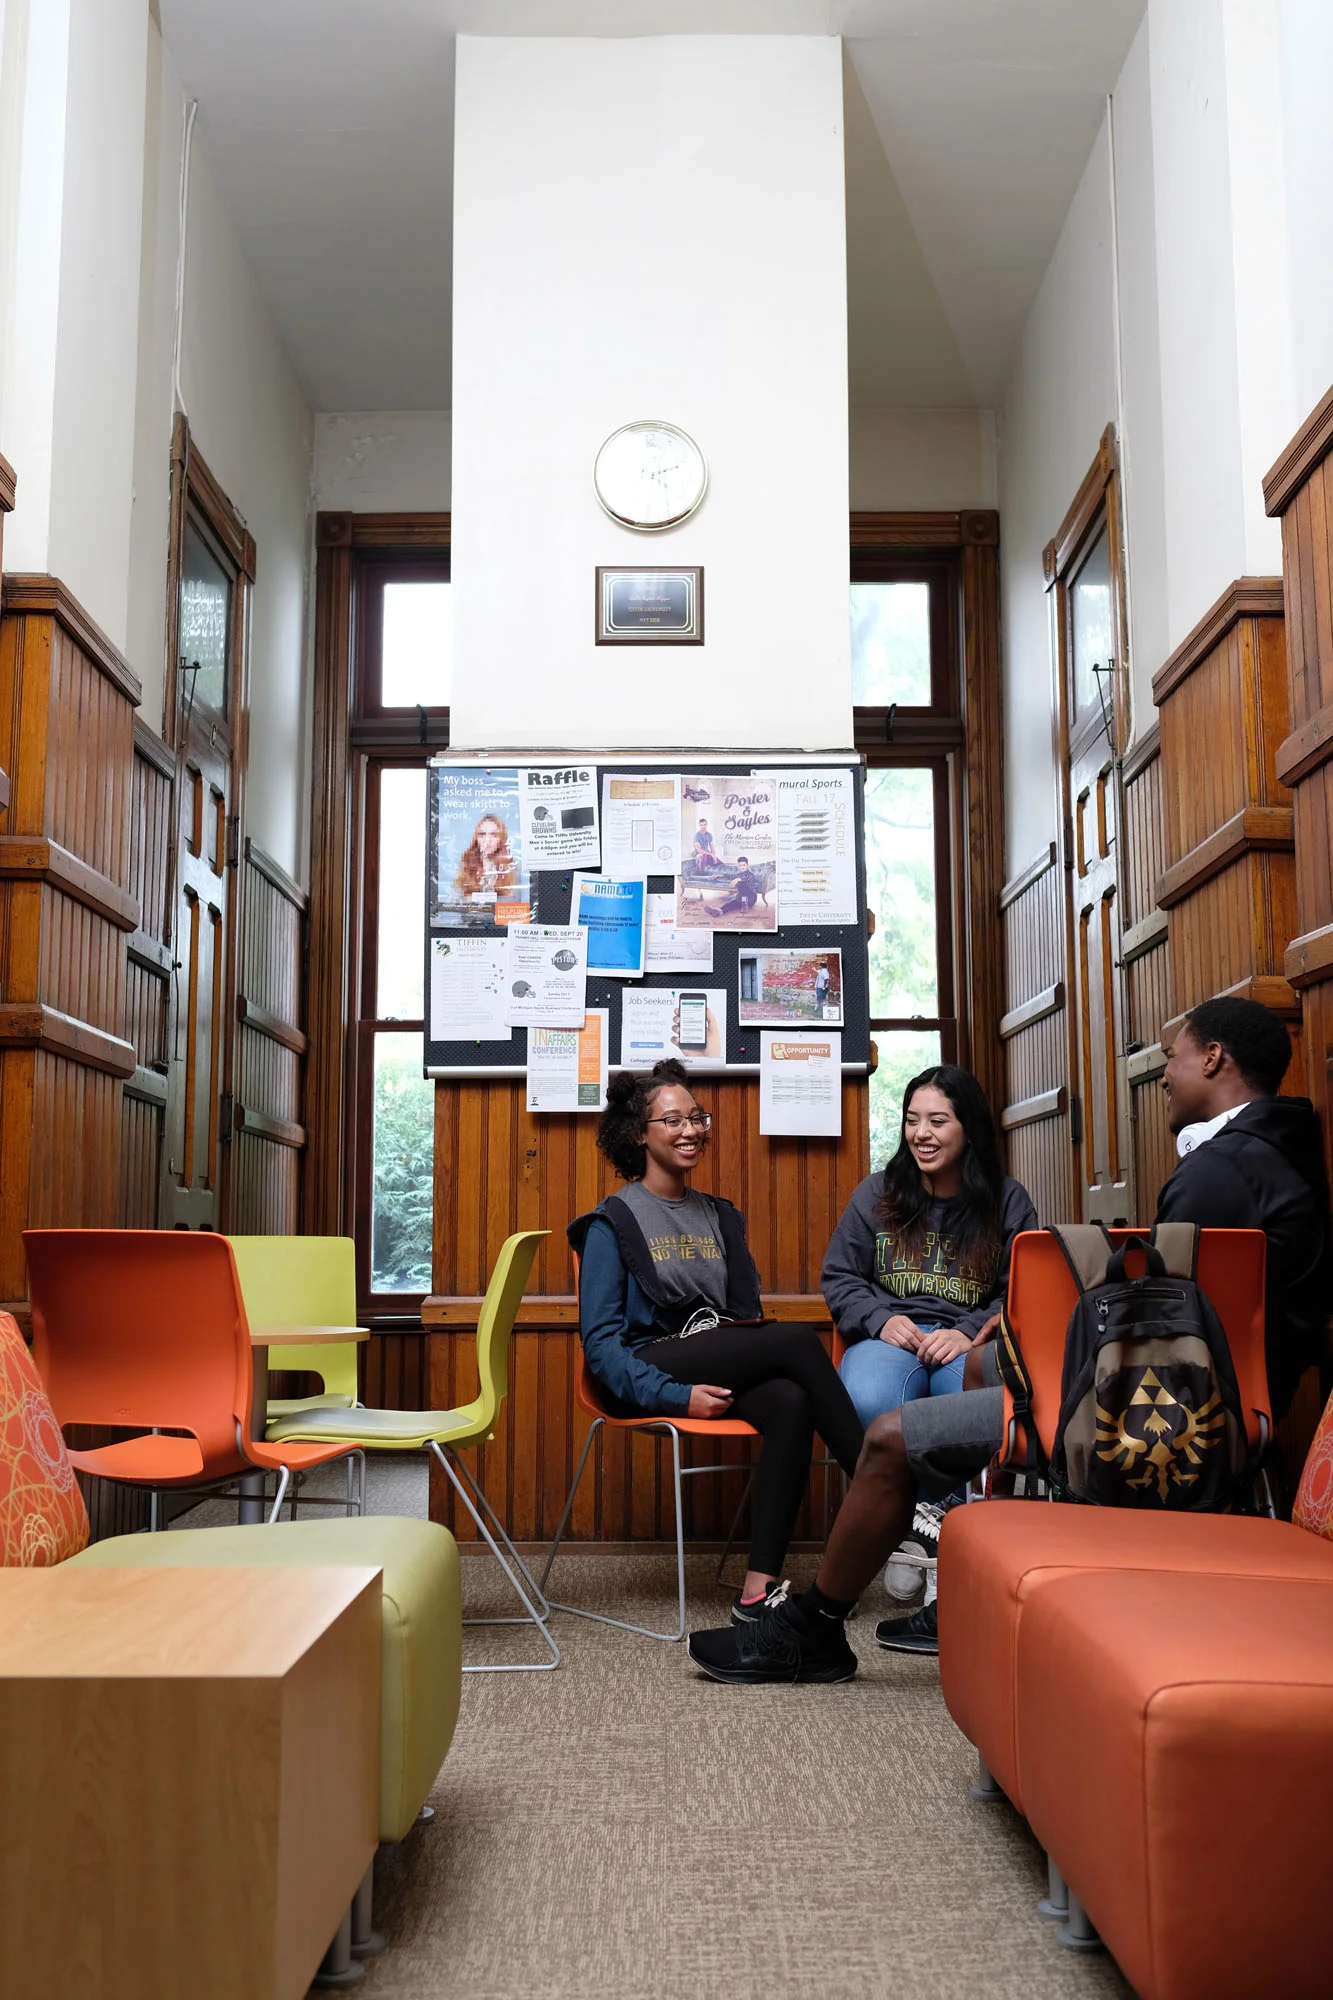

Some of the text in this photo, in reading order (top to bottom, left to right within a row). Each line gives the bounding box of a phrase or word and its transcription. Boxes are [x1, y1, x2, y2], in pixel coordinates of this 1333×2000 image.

[444, 776, 484, 787] My boss
[528, 770, 590, 785] Raffle
[812, 779, 842, 789] Sports
[444, 788, 472, 796] asked
[494, 788, 504, 796] to
[470, 800, 497, 808] skirts
[724, 793, 770, 809] Porter
[743, 806, 751, 816] &
[725, 812, 772, 830] Sayles
[628, 997, 675, 1005] Job Seekers:
[547, 1034, 576, 1046] AFFAIRS
[879, 1272, 986, 1307] UNIVERSIT
